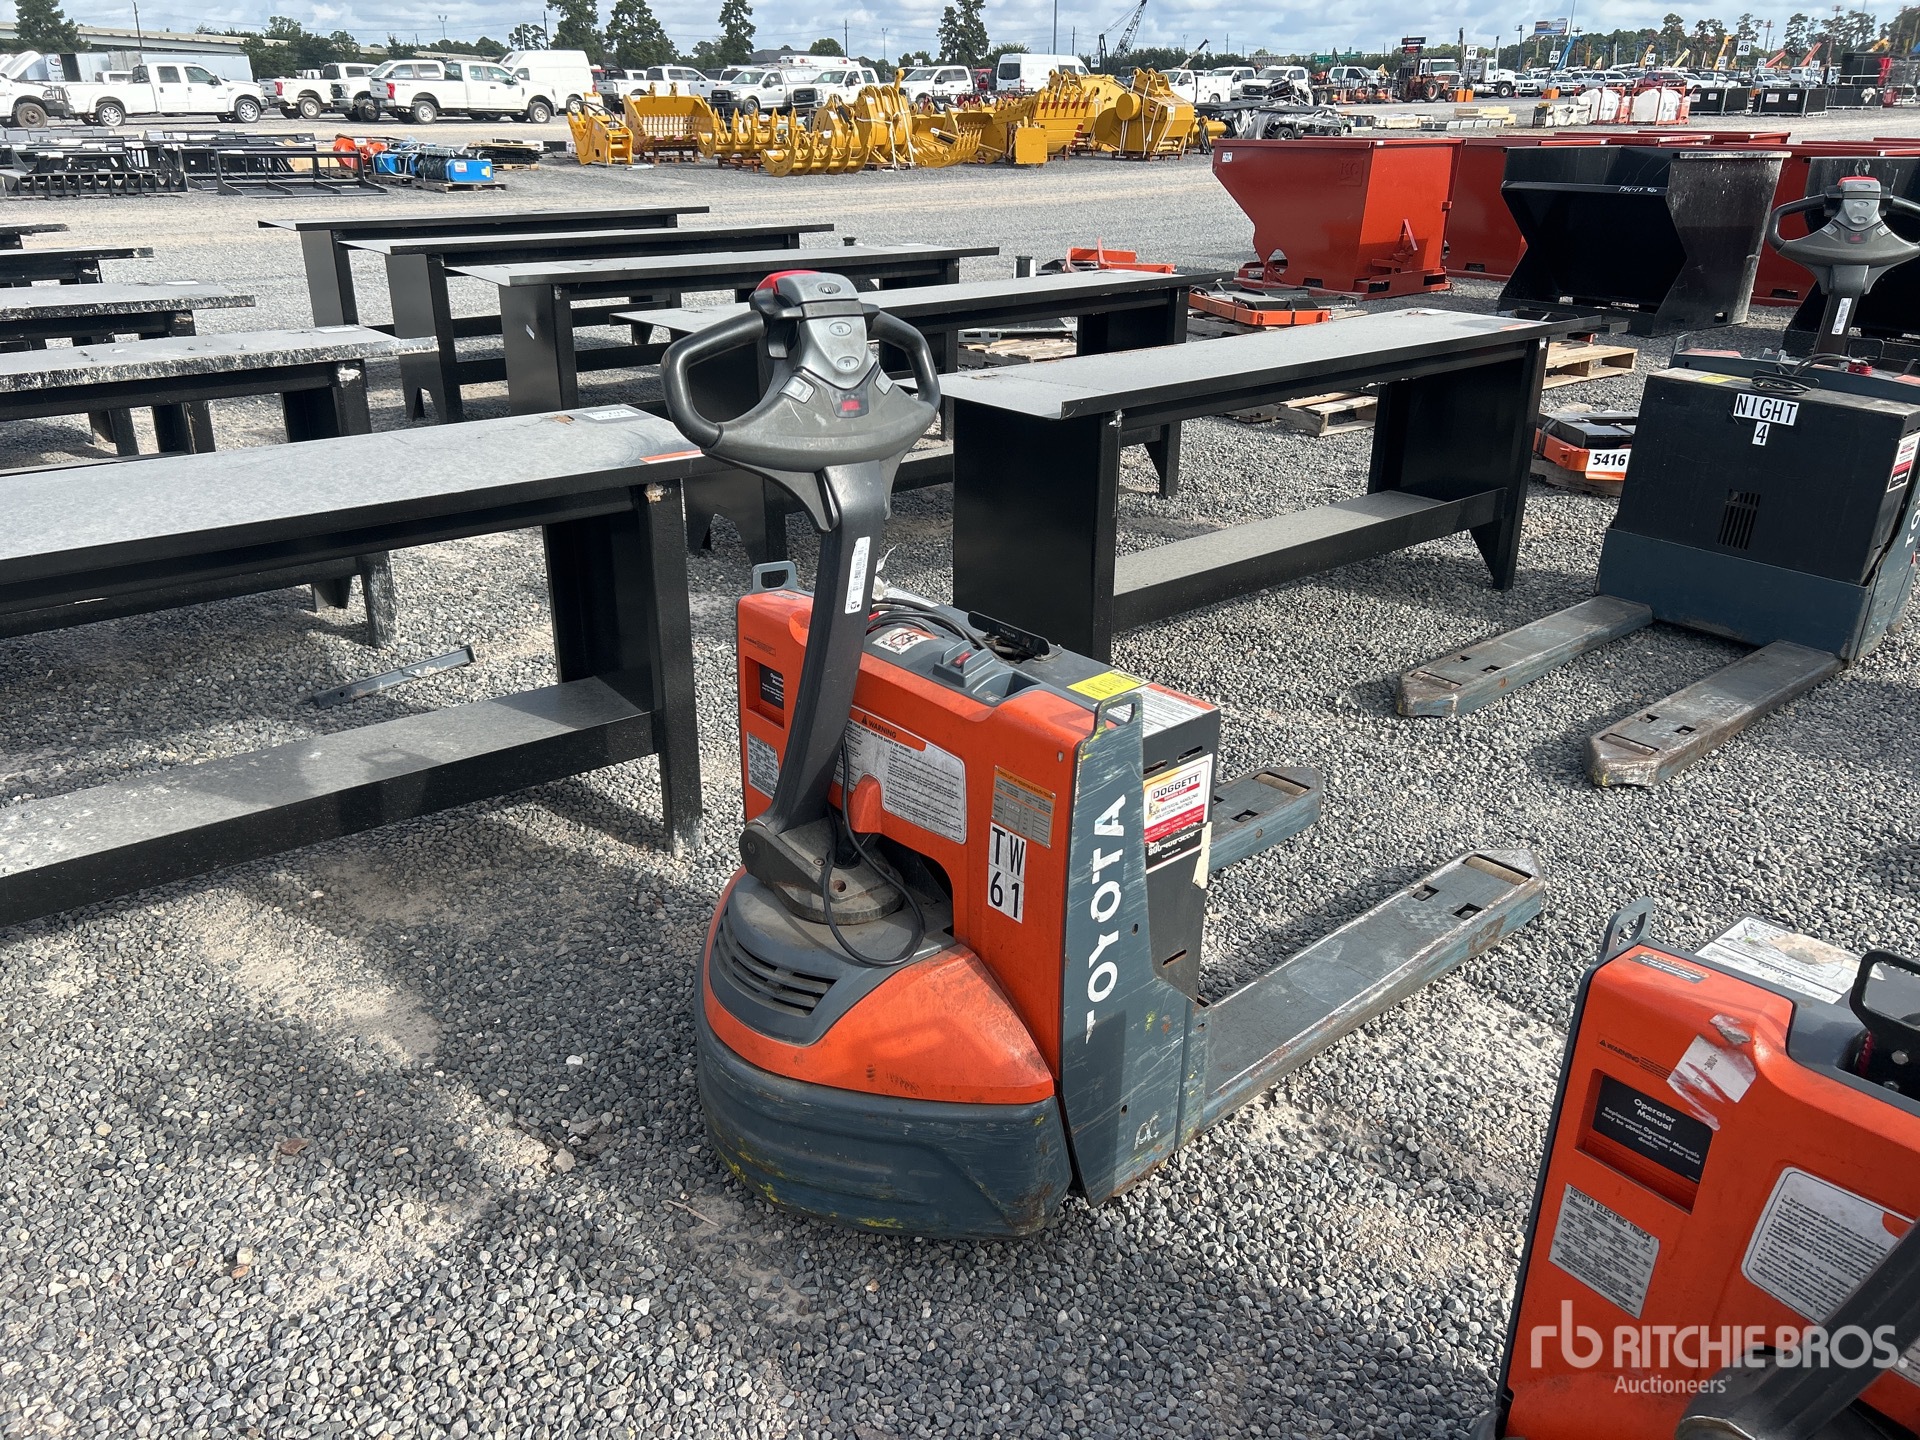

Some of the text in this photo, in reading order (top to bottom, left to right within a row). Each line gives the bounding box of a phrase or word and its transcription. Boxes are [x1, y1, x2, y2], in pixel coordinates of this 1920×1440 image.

[1735, 394, 1797, 424] NIGHT
[1756, 424, 1768, 444] 4
[1592, 453, 1627, 466] 5416
[868, 720, 896, 739] WARNING
[1153, 774, 1200, 800] DOGGETT
[992, 826, 1025, 876] TW
[990, 871, 1020, 919] 61
[1758, 962, 1794, 978] TOYOTA
[1607, 1043, 1640, 1064] WARNING
[1634, 1098, 1676, 1124] Operator
[1636, 1109, 1672, 1132] Manual
[1602, 1112, 1615, 1121] may
[1625, 1124, 1652, 1140] obtained
[1653, 1137, 1668, 1148] from
[1669, 1146, 1684, 1156] your
[1685, 1154, 1700, 1165] local
[1604, 1106, 1700, 1158] Replacement Operator Manuals
[1638, 1136, 1659, 1150] dealer.
[1570, 1187, 1651, 1242] TOYOTA ELECTRIC TRUCK
